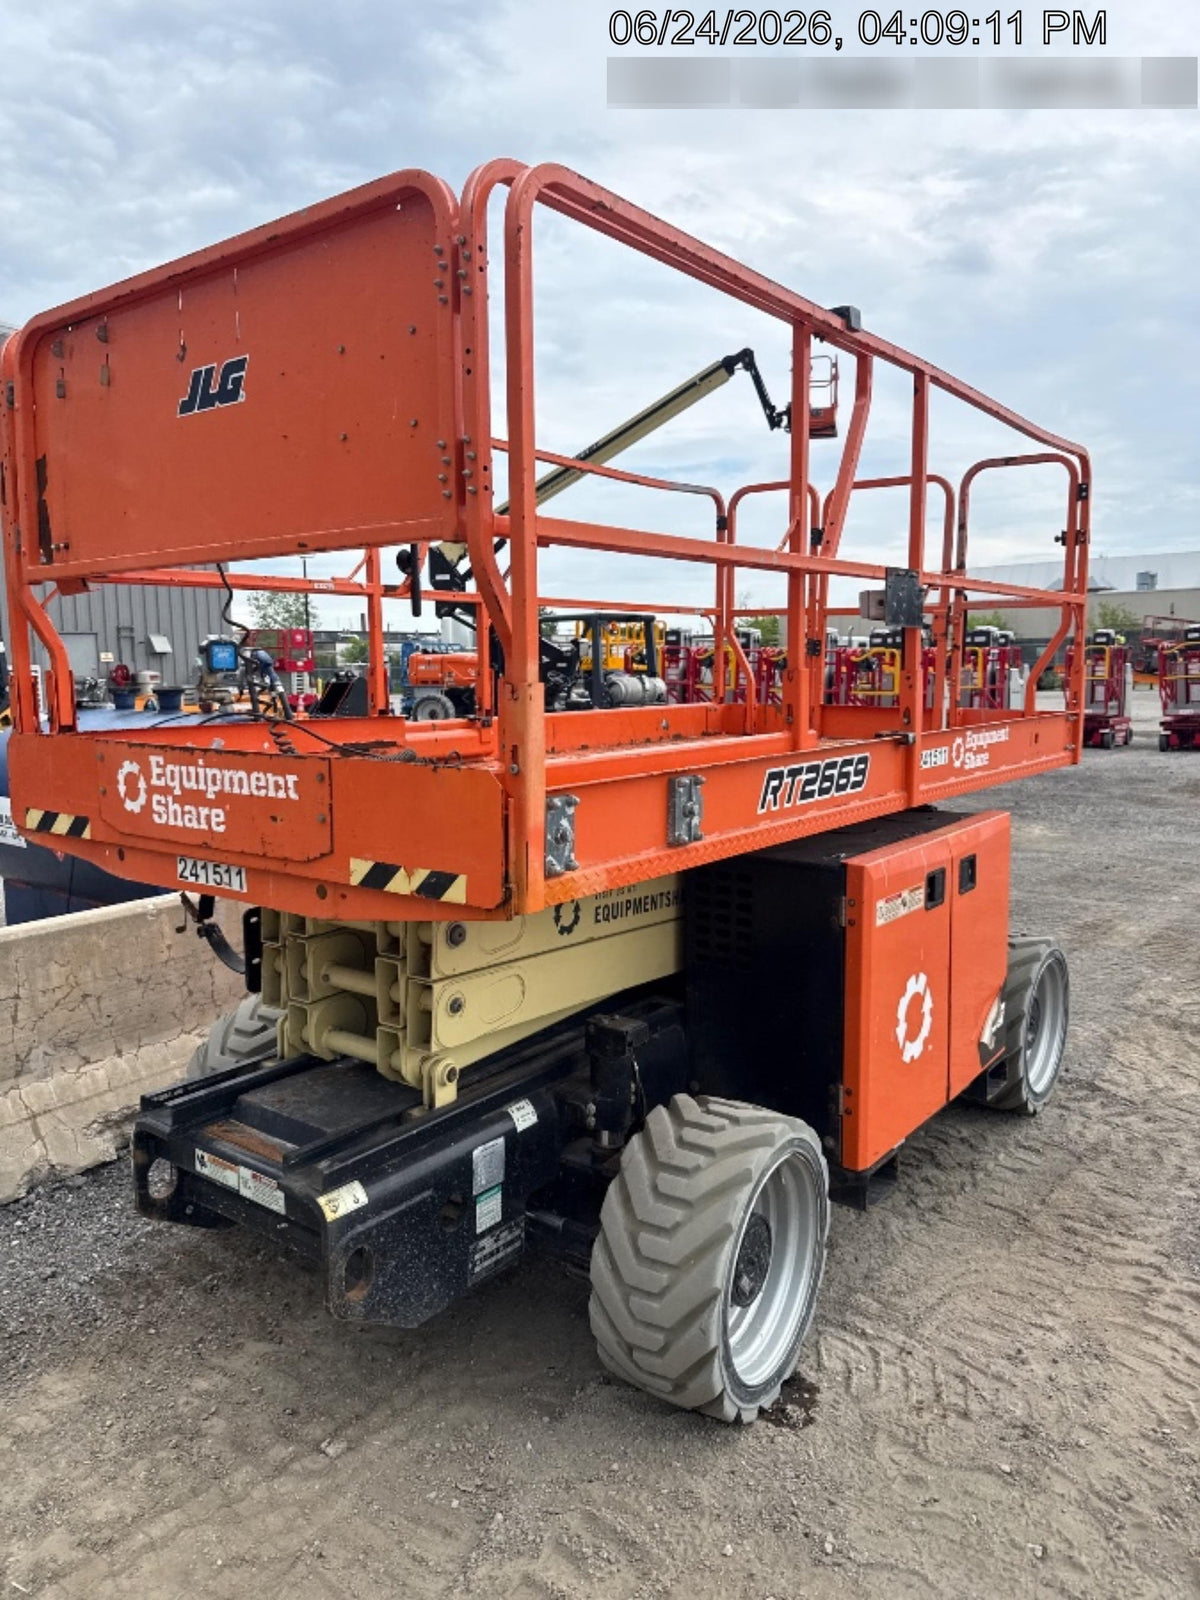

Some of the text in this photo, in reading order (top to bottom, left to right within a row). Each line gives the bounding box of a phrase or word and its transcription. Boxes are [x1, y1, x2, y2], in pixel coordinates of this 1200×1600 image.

[177, 354, 248, 418] JLG
[966, 725, 1009, 750] Equipment
[149, 755, 299, 800] Equipment
[757, 752, 870, 814] RT2669
[152, 794, 226, 832] Share
[178, 857, 244, 890] 241511
